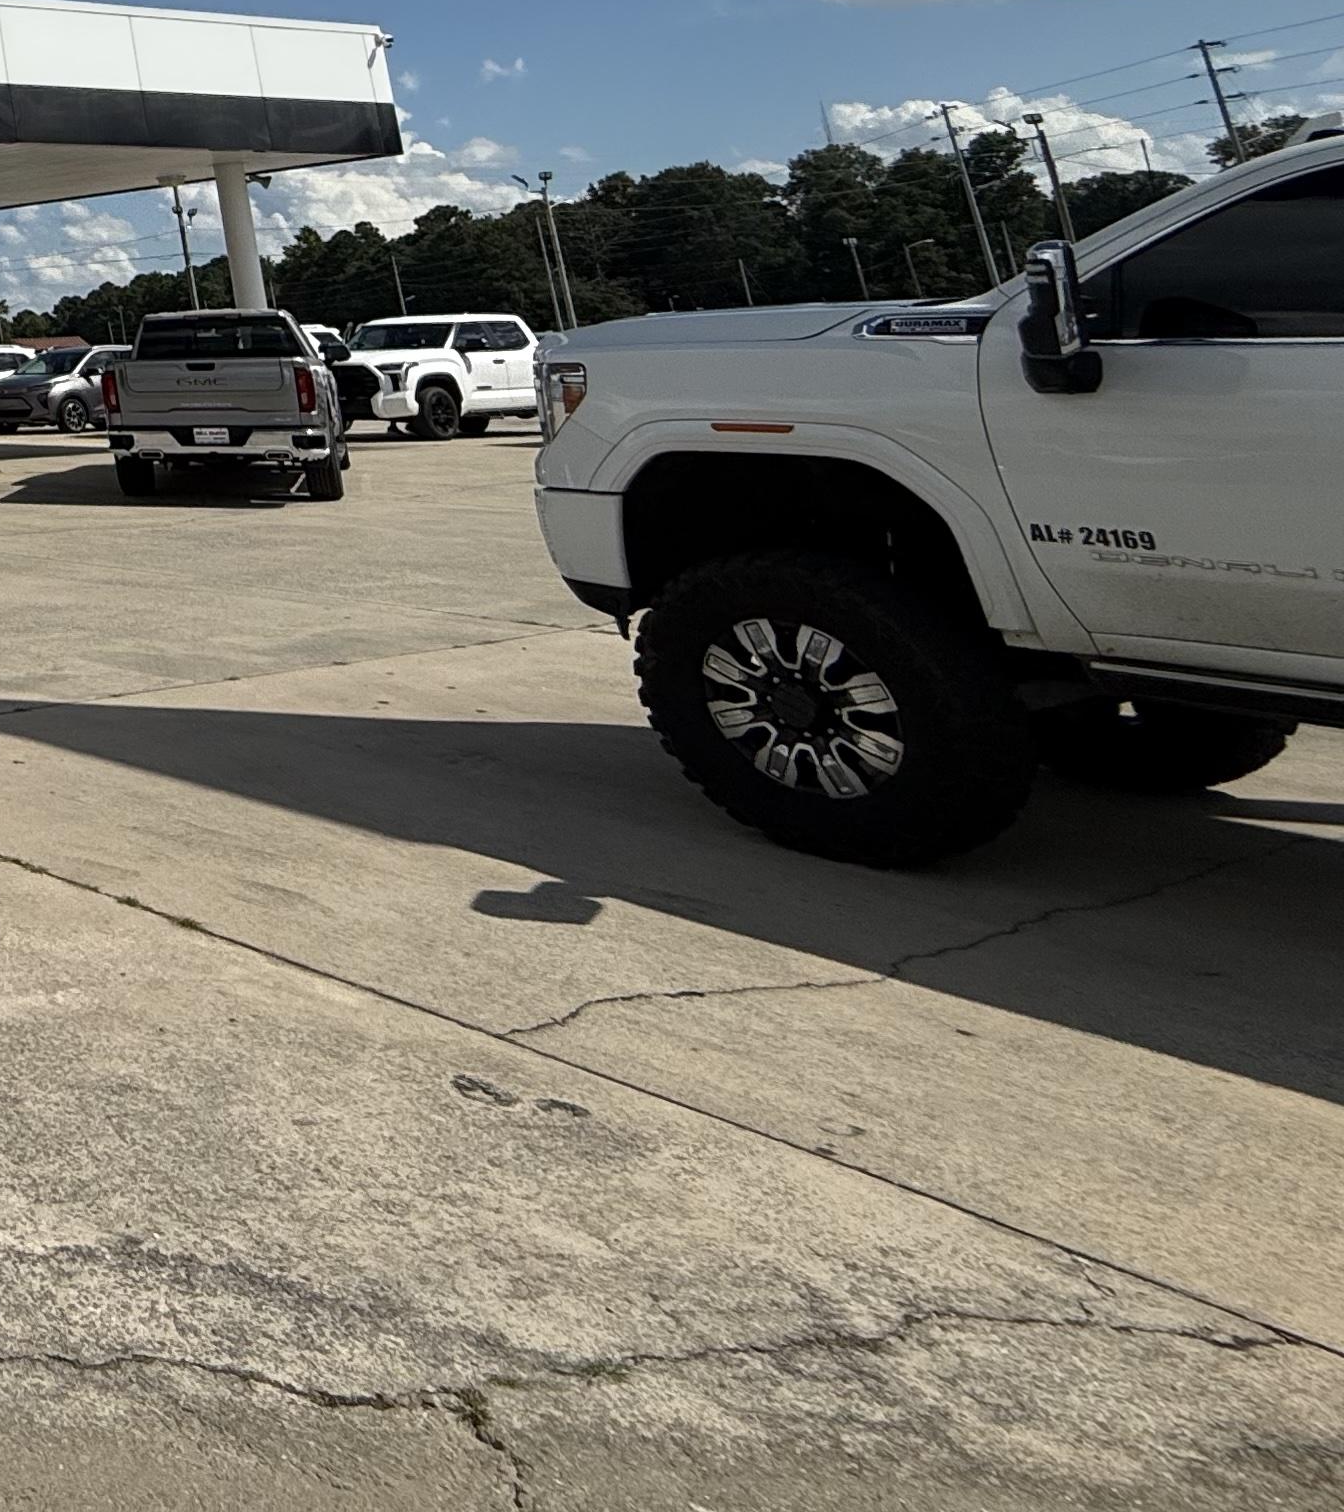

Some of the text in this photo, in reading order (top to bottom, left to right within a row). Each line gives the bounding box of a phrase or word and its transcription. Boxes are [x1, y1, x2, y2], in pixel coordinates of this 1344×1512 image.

[895, 319, 962, 327] DURAMAX
[176, 377, 227, 386] GMC
[1029, 523, 1157, 551] AL# 24169
[1089, 549, 1319, 580] DENALI
